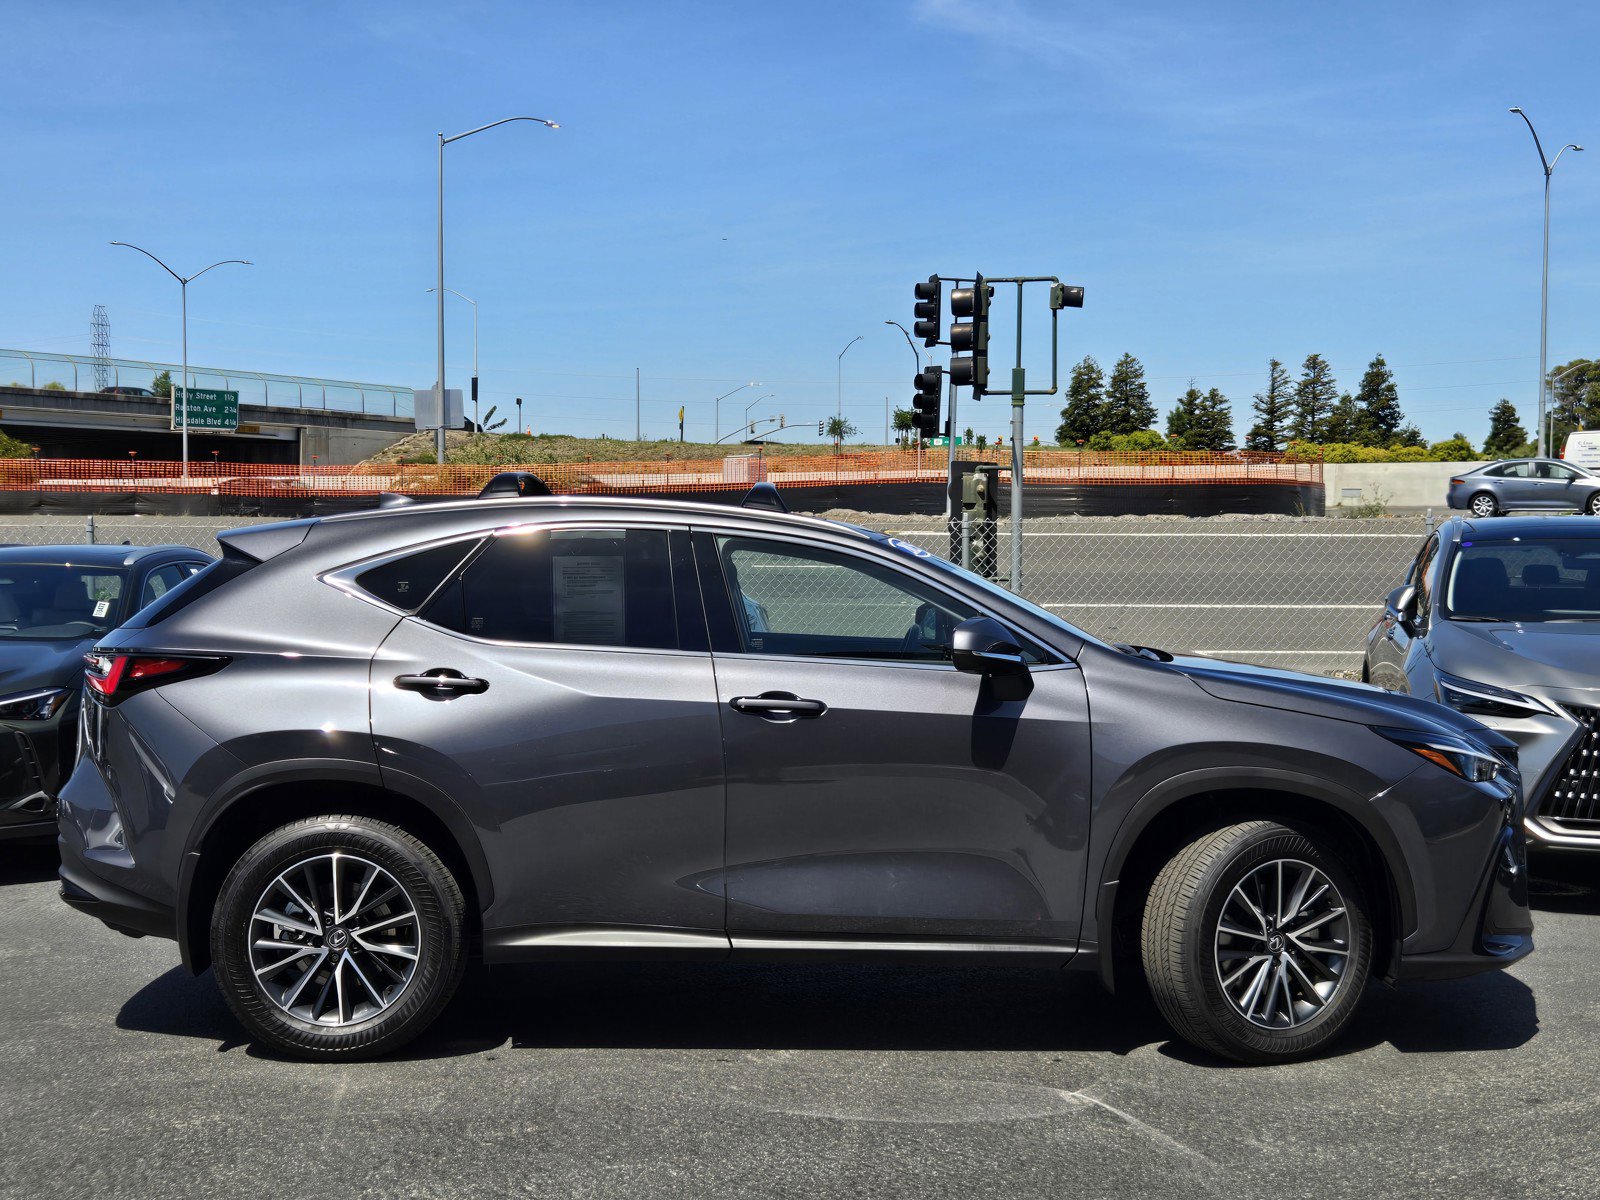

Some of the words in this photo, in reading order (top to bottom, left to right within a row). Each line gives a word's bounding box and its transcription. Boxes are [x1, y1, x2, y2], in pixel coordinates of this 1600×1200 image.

[175, 391, 193, 400] Holy
[195, 392, 217, 400] Street
[203, 405, 217, 413] Ave
[175, 416, 205, 424] Hisdale
